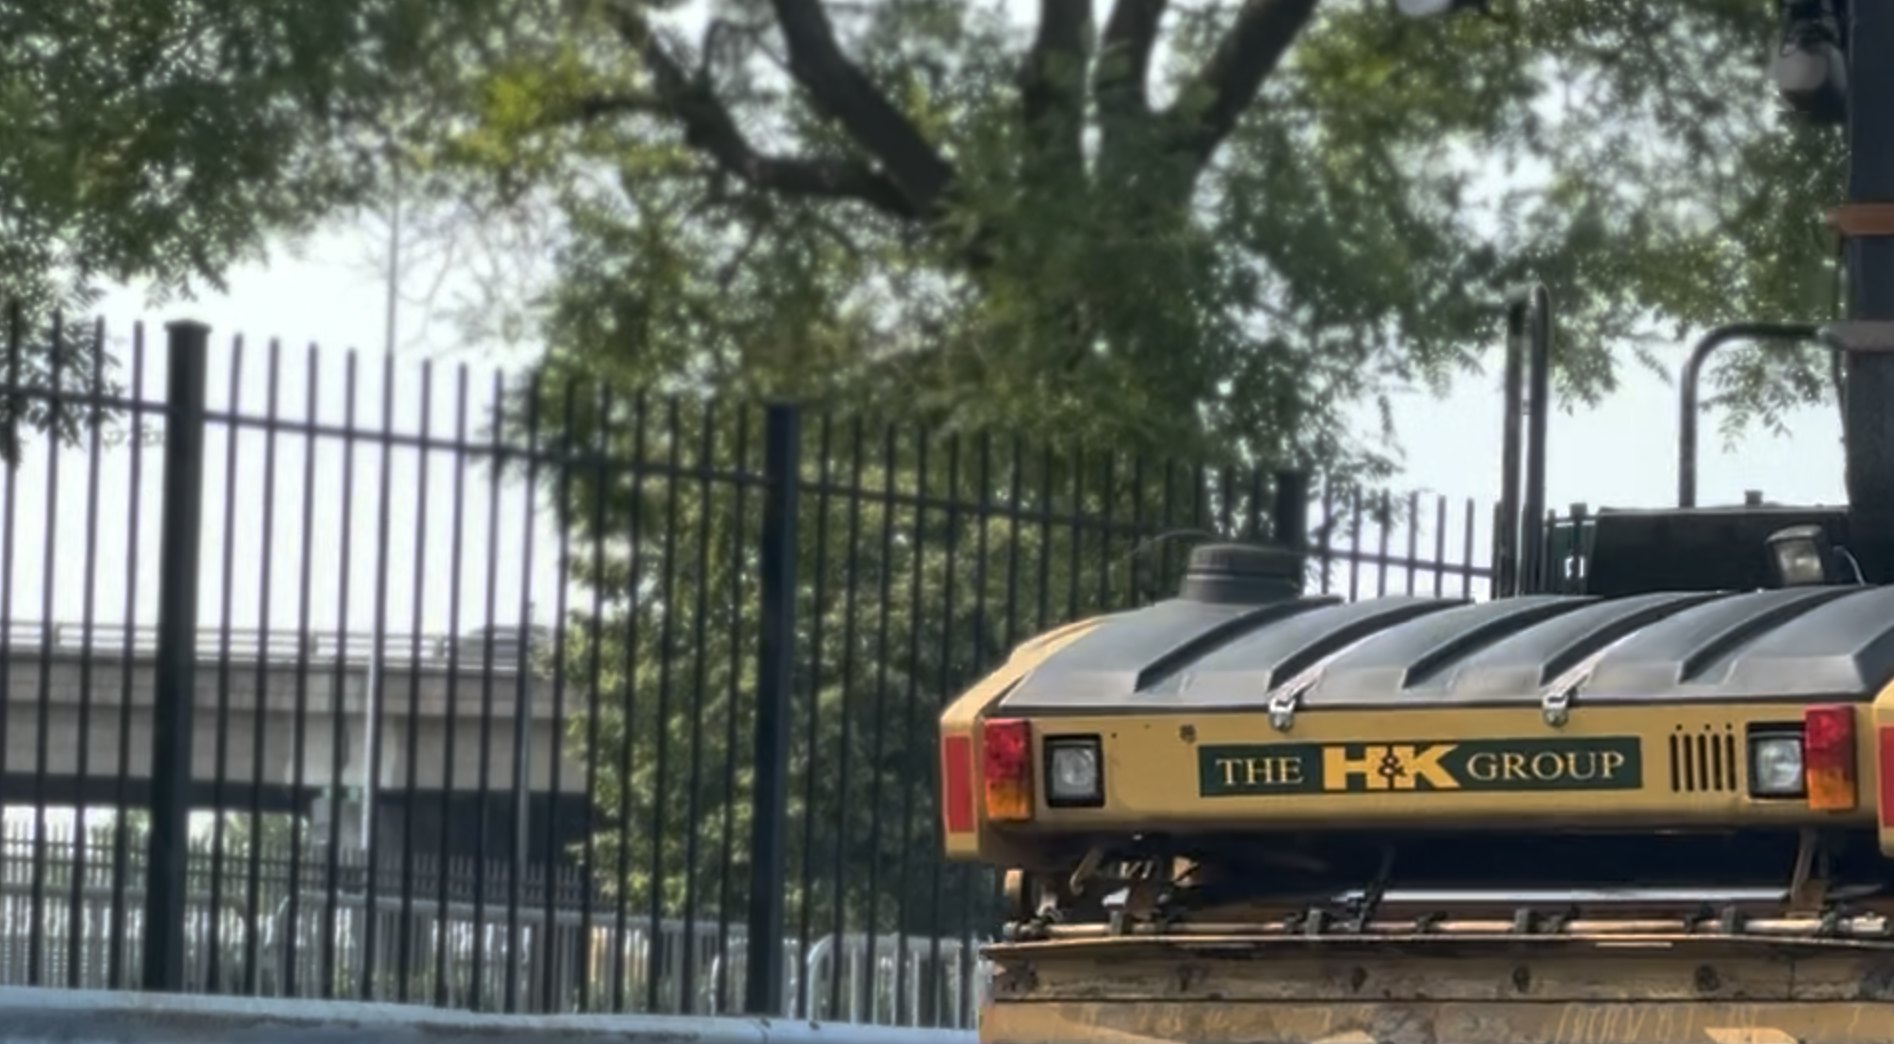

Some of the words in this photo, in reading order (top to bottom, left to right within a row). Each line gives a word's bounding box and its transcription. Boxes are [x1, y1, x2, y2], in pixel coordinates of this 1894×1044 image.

[1215, 756, 1304, 787] THE
[1320, 744, 1461, 790] H&K
[1466, 750, 1625, 781] GROUP
